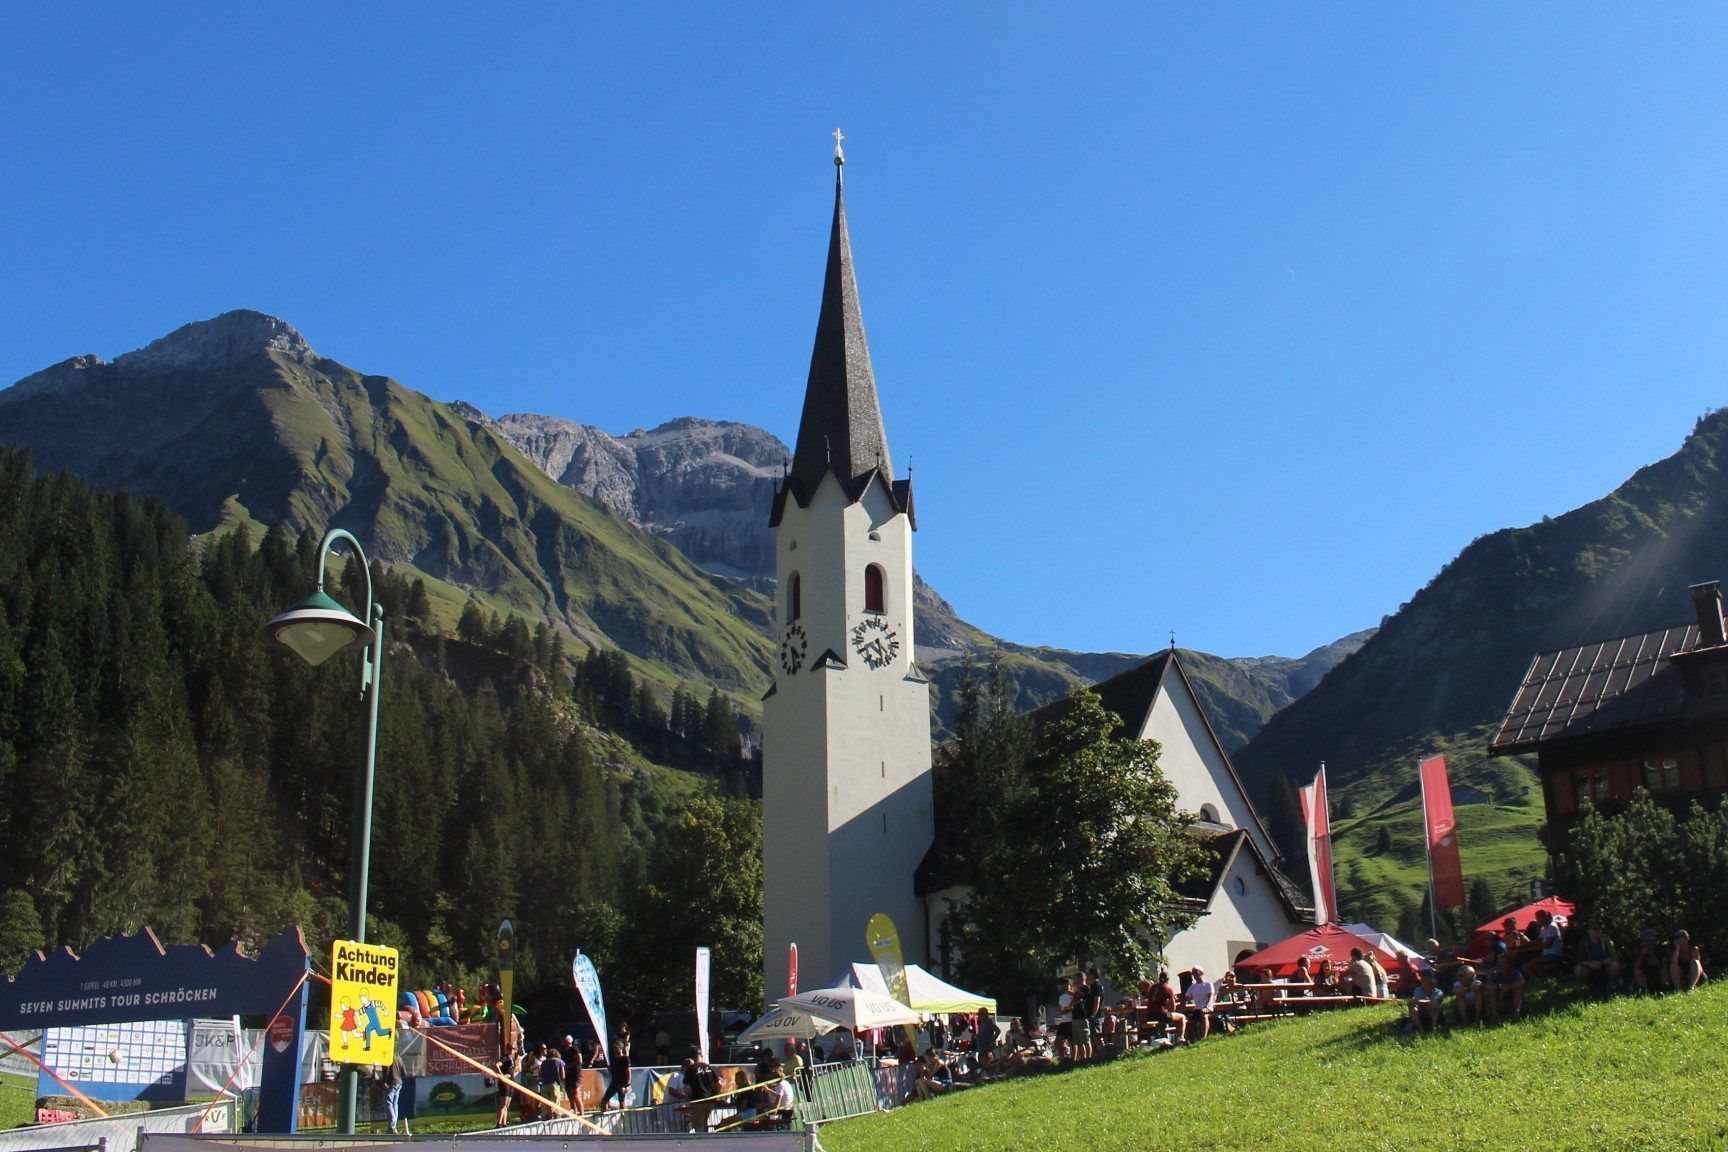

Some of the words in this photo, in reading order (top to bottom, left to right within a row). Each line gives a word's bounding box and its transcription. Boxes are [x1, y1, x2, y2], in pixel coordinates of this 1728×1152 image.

[337, 946, 396, 970] Achtung
[336, 962, 395, 986] Kinder
[20, 1001, 53, 1014] SEVEN
[58, 997, 106, 1012] SUMMITS
[111, 994, 140, 1007] TOUR
[145, 988, 217, 1005] SCHRÖCKEN
